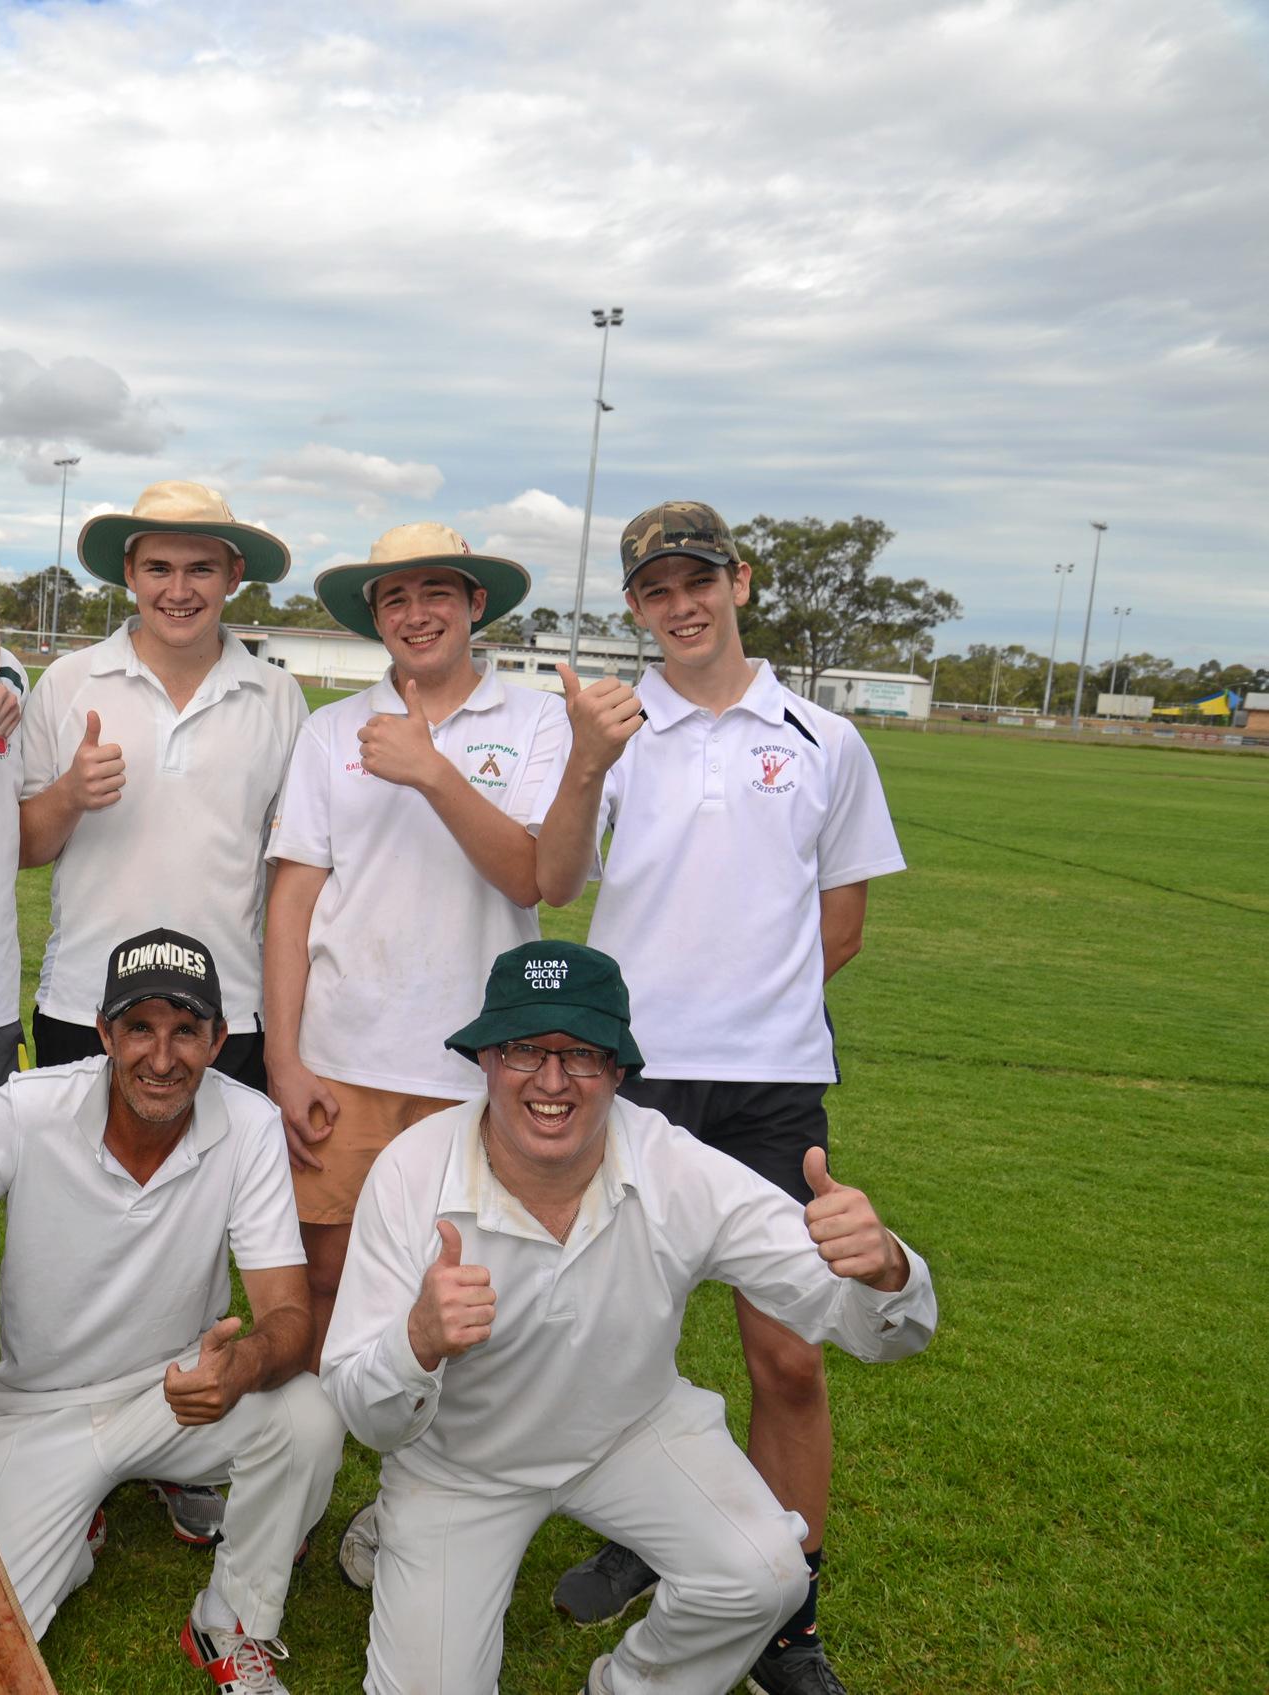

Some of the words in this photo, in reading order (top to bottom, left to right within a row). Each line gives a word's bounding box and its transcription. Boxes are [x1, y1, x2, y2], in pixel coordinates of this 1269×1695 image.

[466, 743, 519, 758] Dalrymple
[751, 745, 798, 759] WARWICK
[470, 775, 507, 788] Dongers
[752, 780, 795, 794] CRICKET
[117, 942, 206, 975] LOWNDES
[524, 960, 568, 970] ALLORA
[118, 964, 156, 980] CELEBRATE
[524, 969, 569, 980] CRICKET
[531, 979, 561, 990] CLUB
